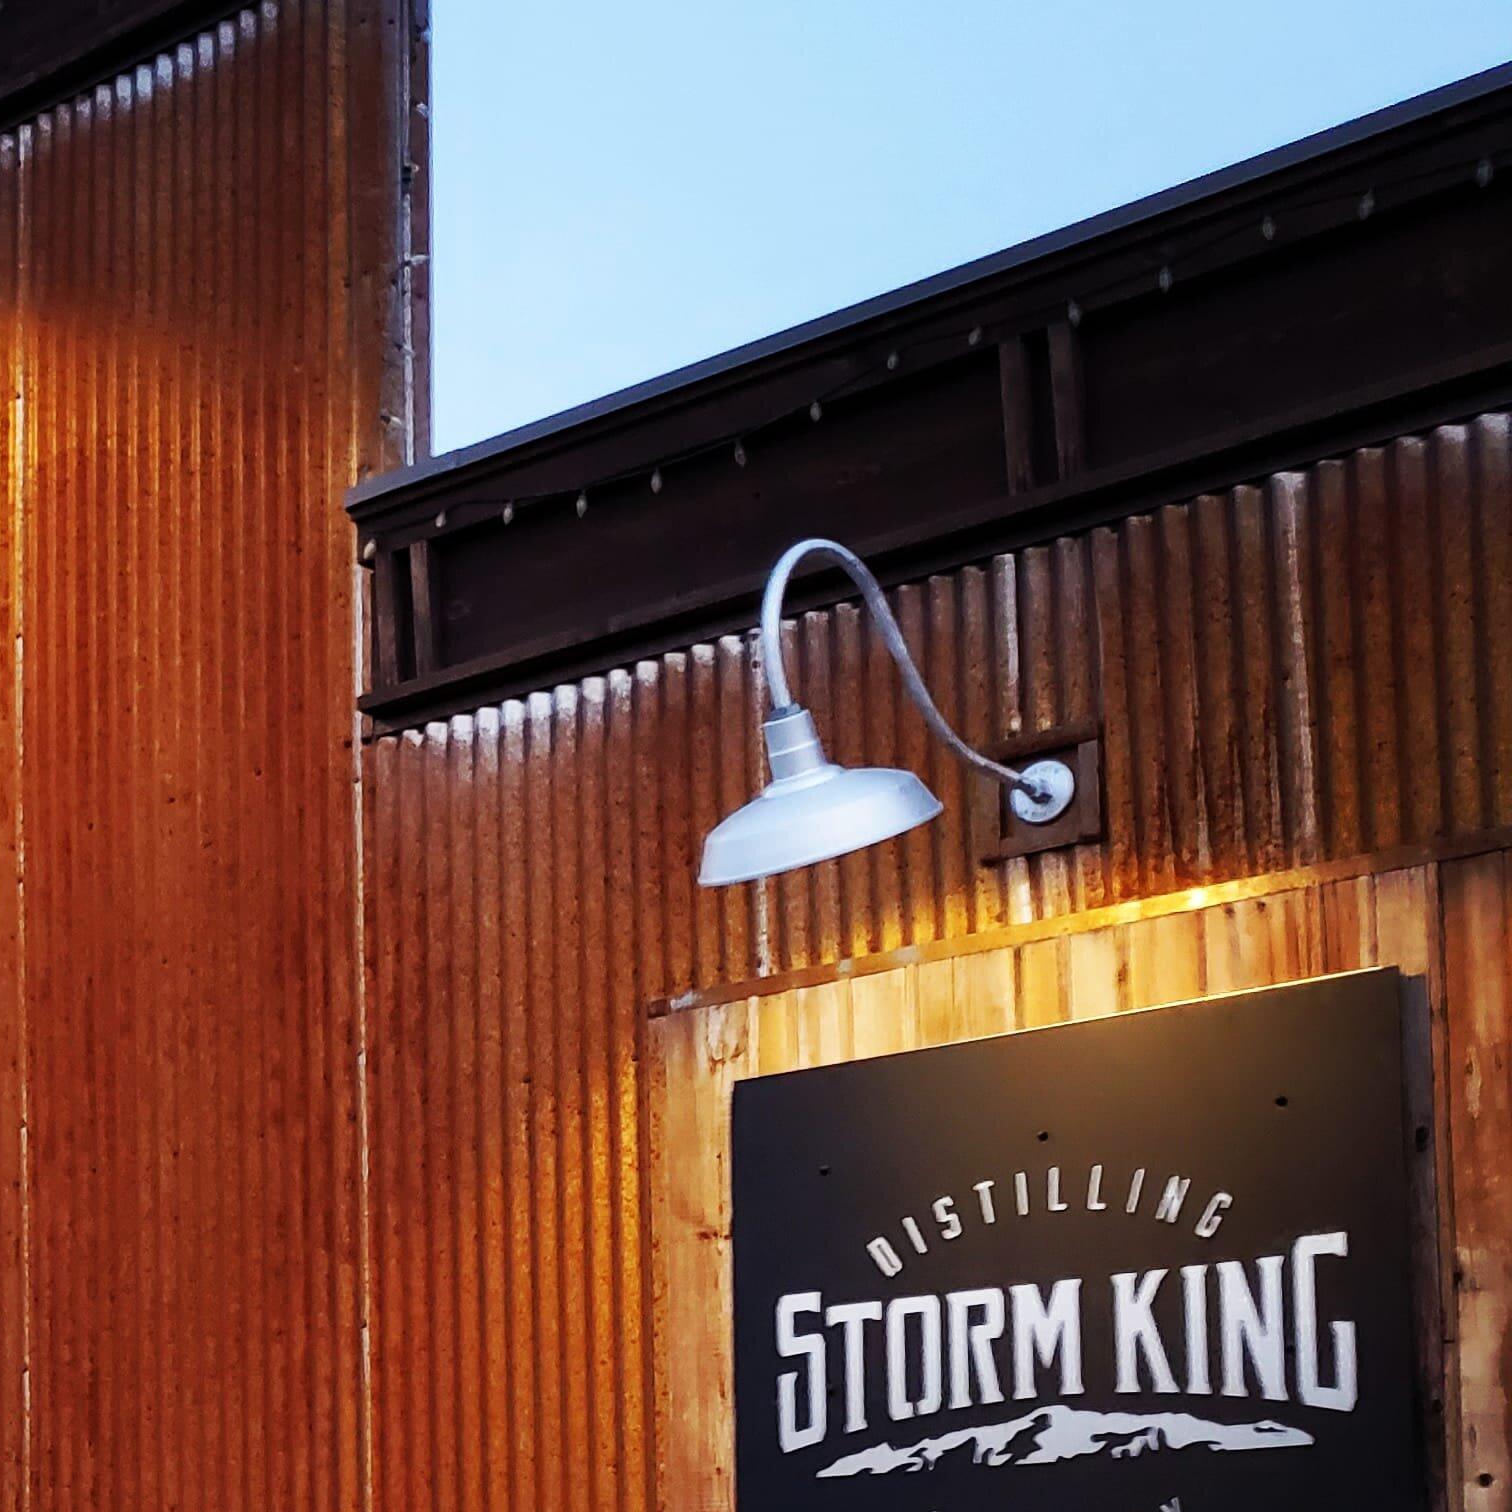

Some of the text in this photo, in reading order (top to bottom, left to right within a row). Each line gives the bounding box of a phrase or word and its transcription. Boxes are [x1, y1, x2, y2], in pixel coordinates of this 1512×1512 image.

[867, 1164, 1233, 1278] DISTILLING
[775, 1231, 1359, 1454] STORM KING
